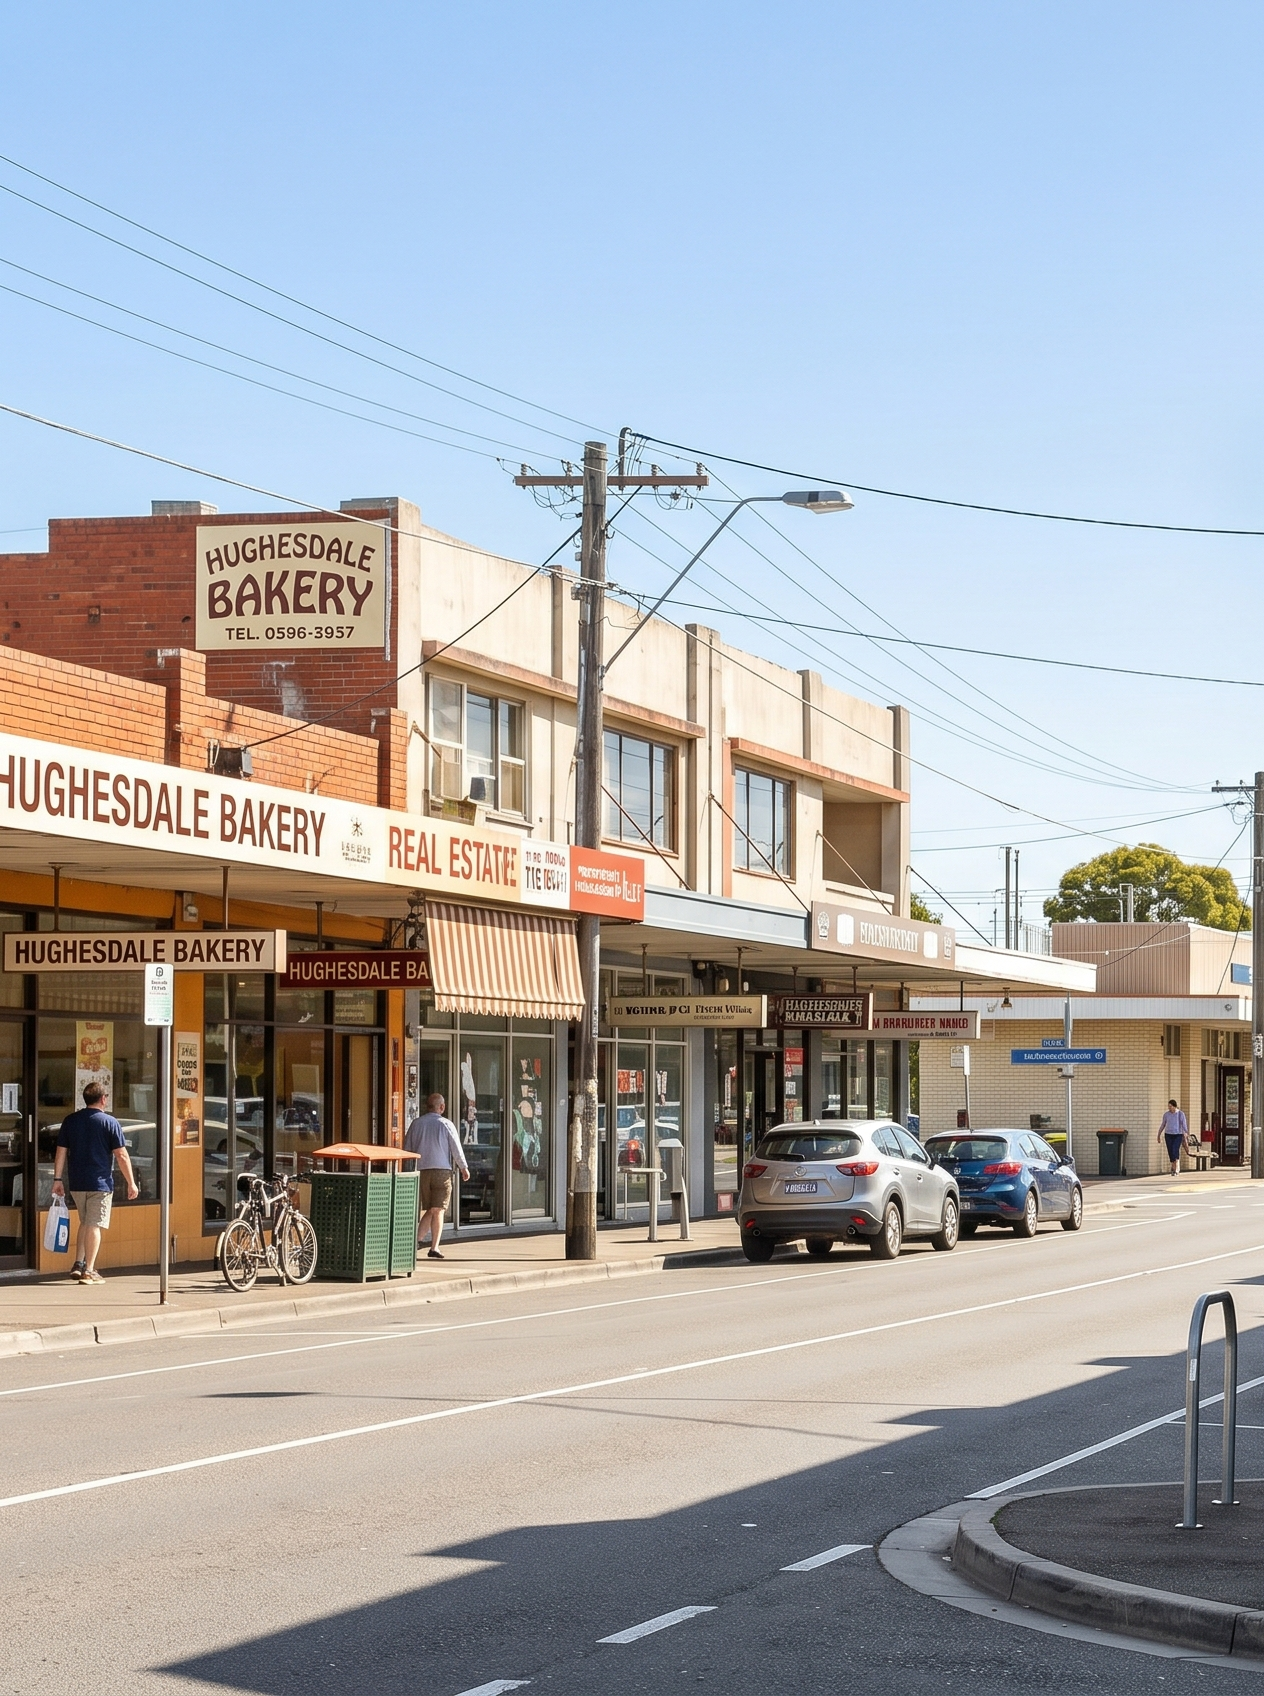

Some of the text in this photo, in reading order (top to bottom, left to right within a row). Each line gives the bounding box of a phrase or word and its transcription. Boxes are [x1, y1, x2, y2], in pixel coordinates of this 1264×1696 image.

[205, 532, 376, 575] HUGHESDALE
[208, 570, 374, 619] BAKERY
[225, 626, 355, 640] TEL. 0596-3957
[220, 793, 326, 857] BAKERY
[389, 825, 442, 875] REAL
[15, 938, 266, 965] HUGHESDALE BAKERY
[289, 961, 432, 981] HUGHESDALE BA
